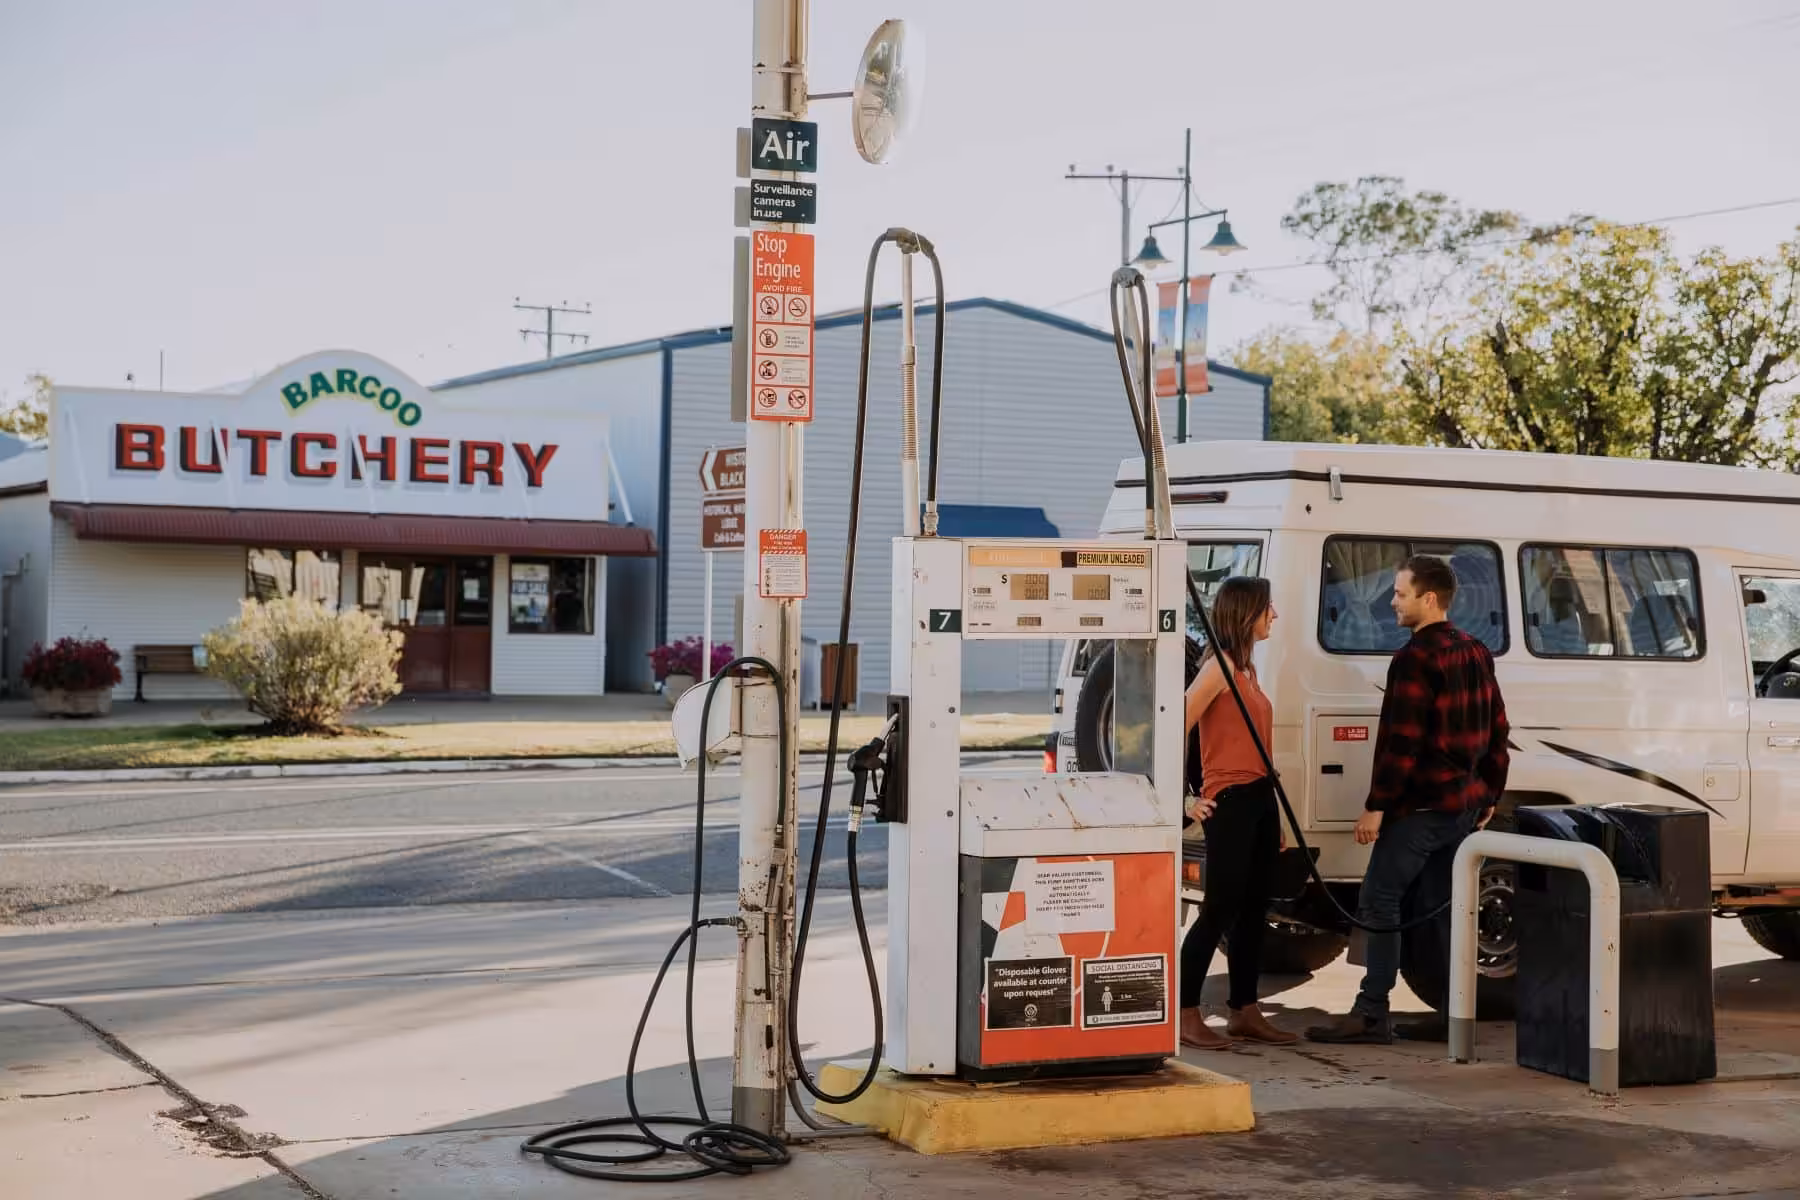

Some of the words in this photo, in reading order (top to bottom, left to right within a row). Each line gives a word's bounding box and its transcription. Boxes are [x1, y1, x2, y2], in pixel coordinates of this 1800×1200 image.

[760, 130, 810, 161] Air
[754, 183, 813, 196] Surveillance
[754, 197, 796, 207] cameras
[753, 207, 763, 217] in
[764, 209, 783, 218] use
[757, 233, 788, 259] Stop
[756, 256, 801, 283] Engine
[762, 284, 785, 292] AVOID
[786, 285, 803, 293] FIRE
[281, 368, 422, 426] BARCOO
[115, 422, 560, 488] BUTCHERY
[769, 533, 797, 541] DANGER
[1078, 553, 1109, 564] PREMIUM
[1110, 554, 1145, 565] UNLEADED
[938, 611, 952, 630] 7
[1163, 611, 1171, 630] 6
[1042, 966, 1067, 975] Gloves
[1091, 964, 1115, 973] SOCIAL
[1116, 961, 1157, 970] DISTANCING
[994, 978, 1028, 987] available
[1039, 977, 1067, 985] counter
[1004, 990, 1024, 999] upon
